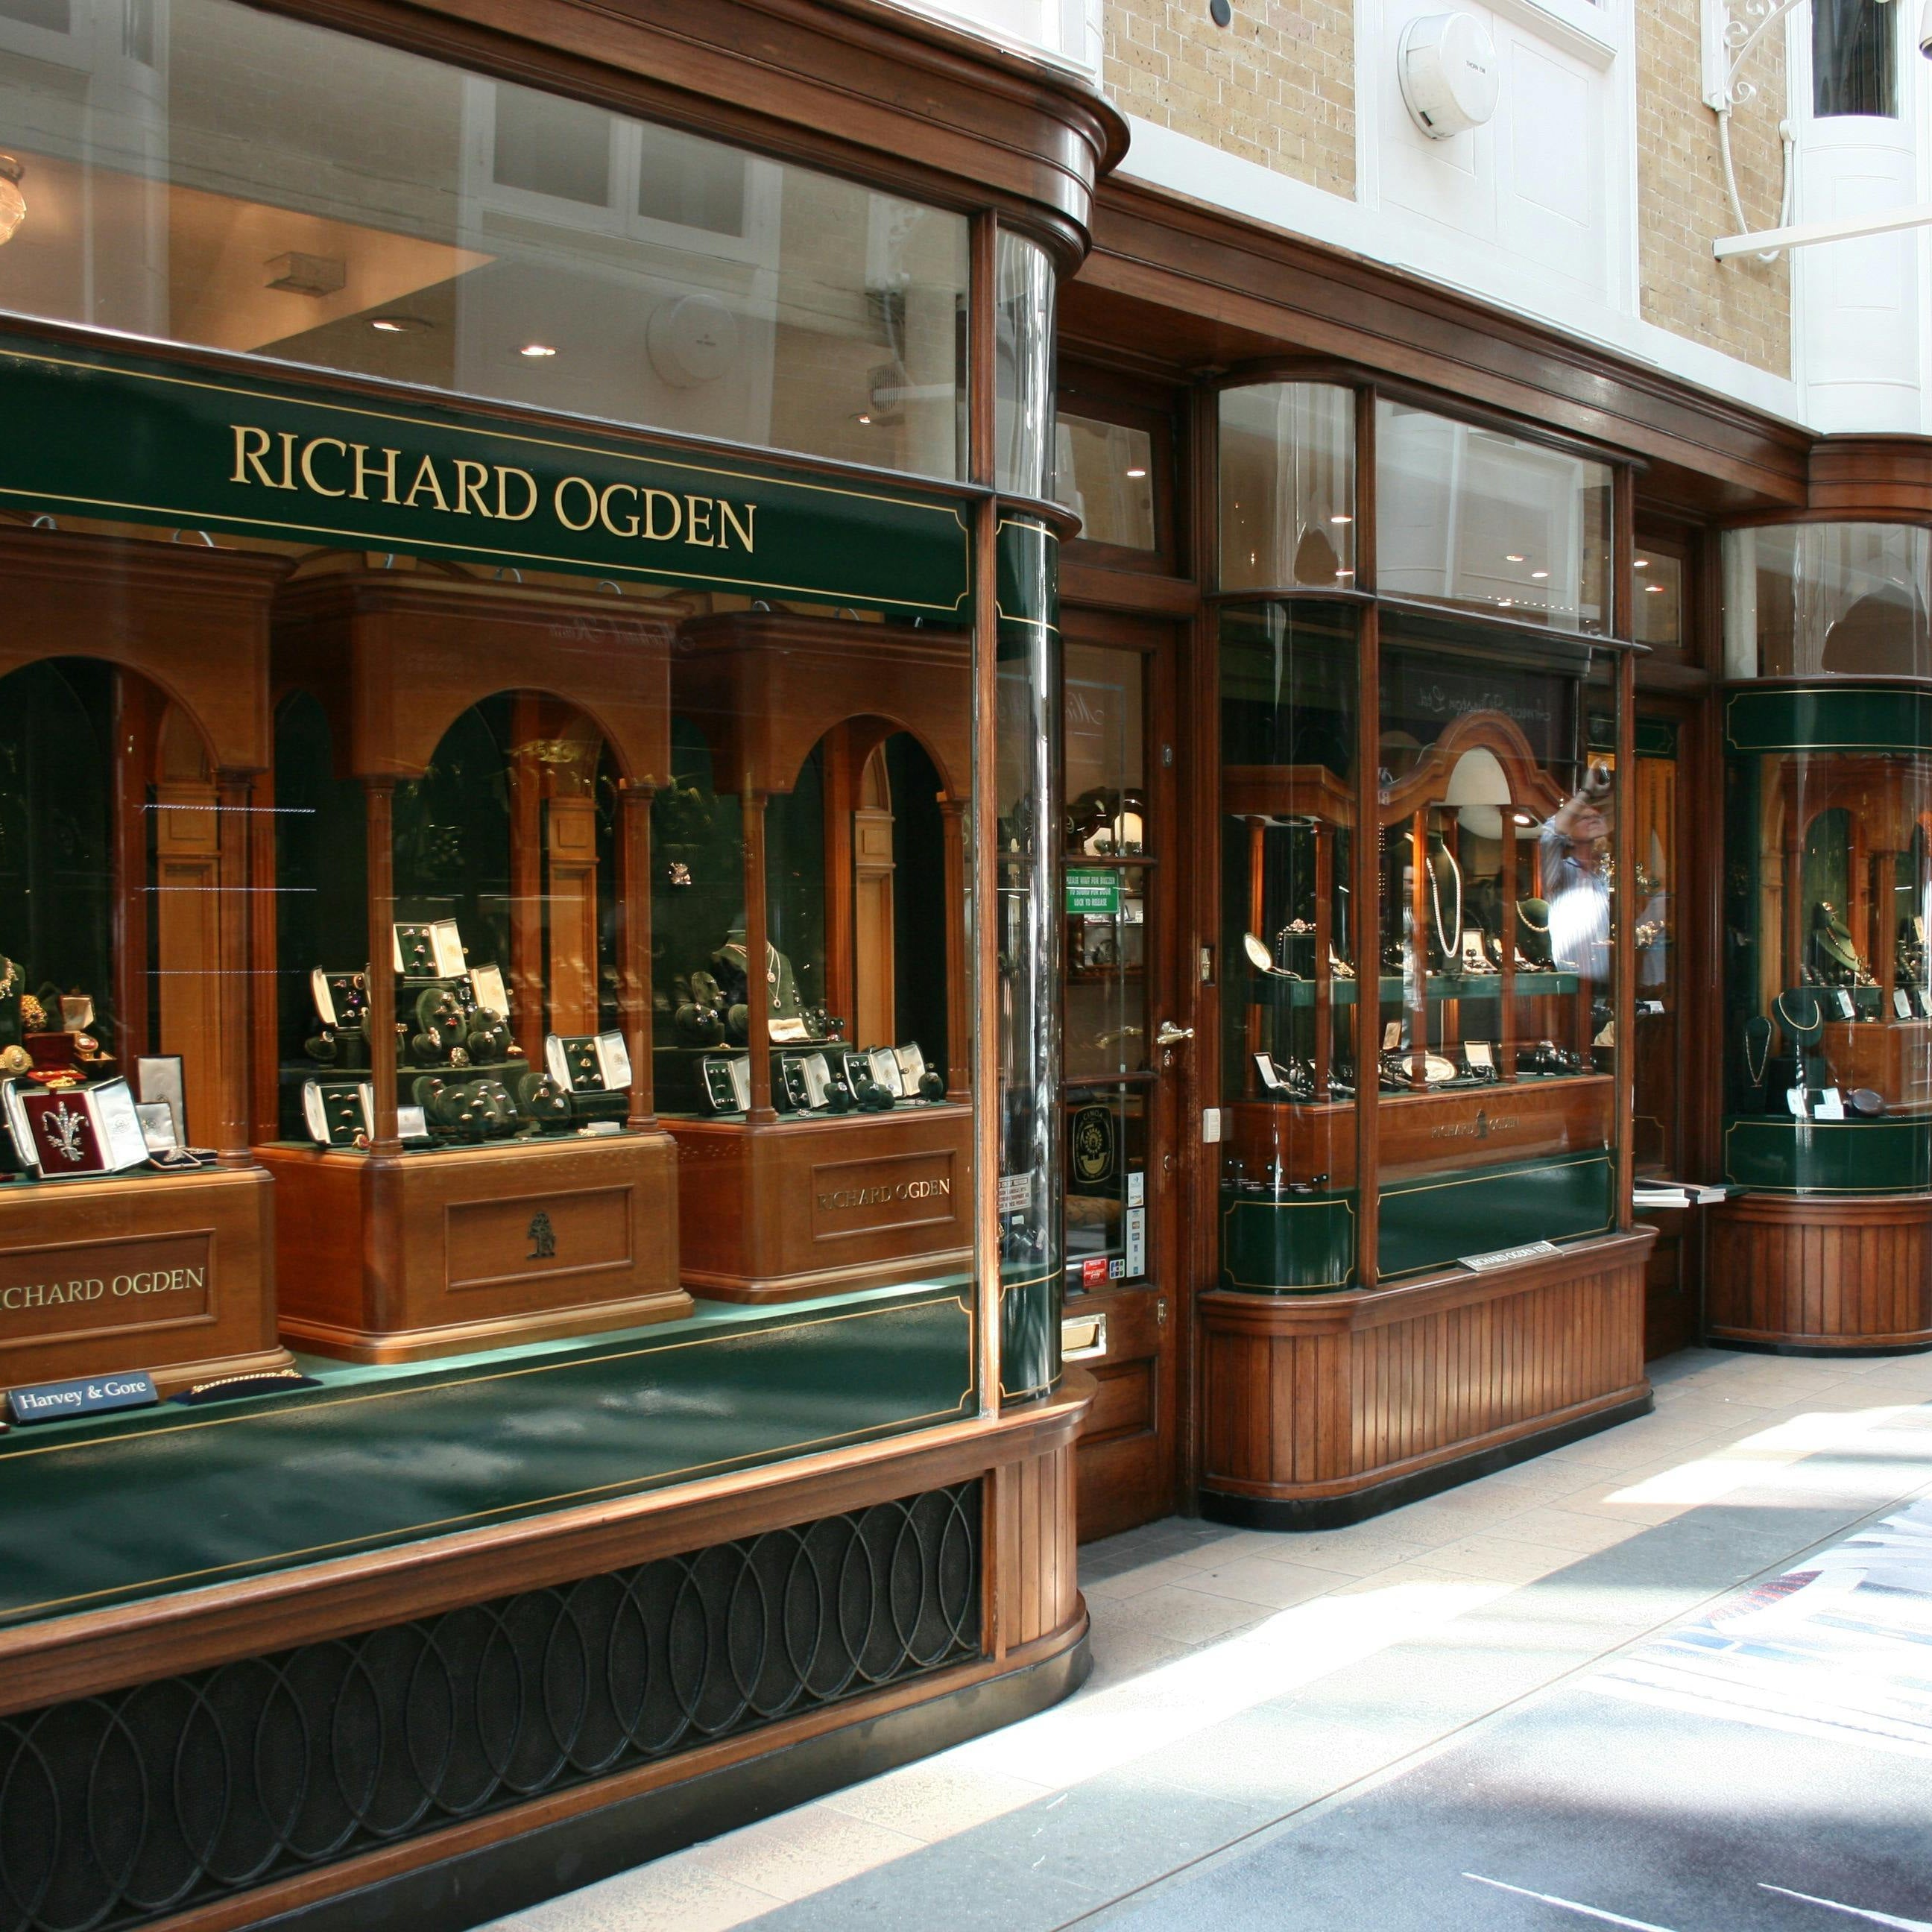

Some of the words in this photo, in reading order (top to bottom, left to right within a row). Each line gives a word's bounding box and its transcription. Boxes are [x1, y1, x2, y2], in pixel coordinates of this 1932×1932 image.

[229, 424, 538, 521] RICHARD
[555, 476, 757, 553] OGDEN
[1090, 876, 1099, 885] FOR
[1074, 898, 1085, 907] LOCK
[1085, 898, 1091, 907] TO
[817, 1185, 891, 1211] RICHARD
[896, 1178, 950, 1199] OGDEN
[1467, 1253, 1508, 1267] RICHARD
[1506, 1247, 1536, 1260] OGDEN
[113, 1267, 205, 1297] OGDEN
[19, 1389, 83, 1409] Harvey
[87, 1384, 104, 1399] &
[104, 1381, 148, 1397] Gore
